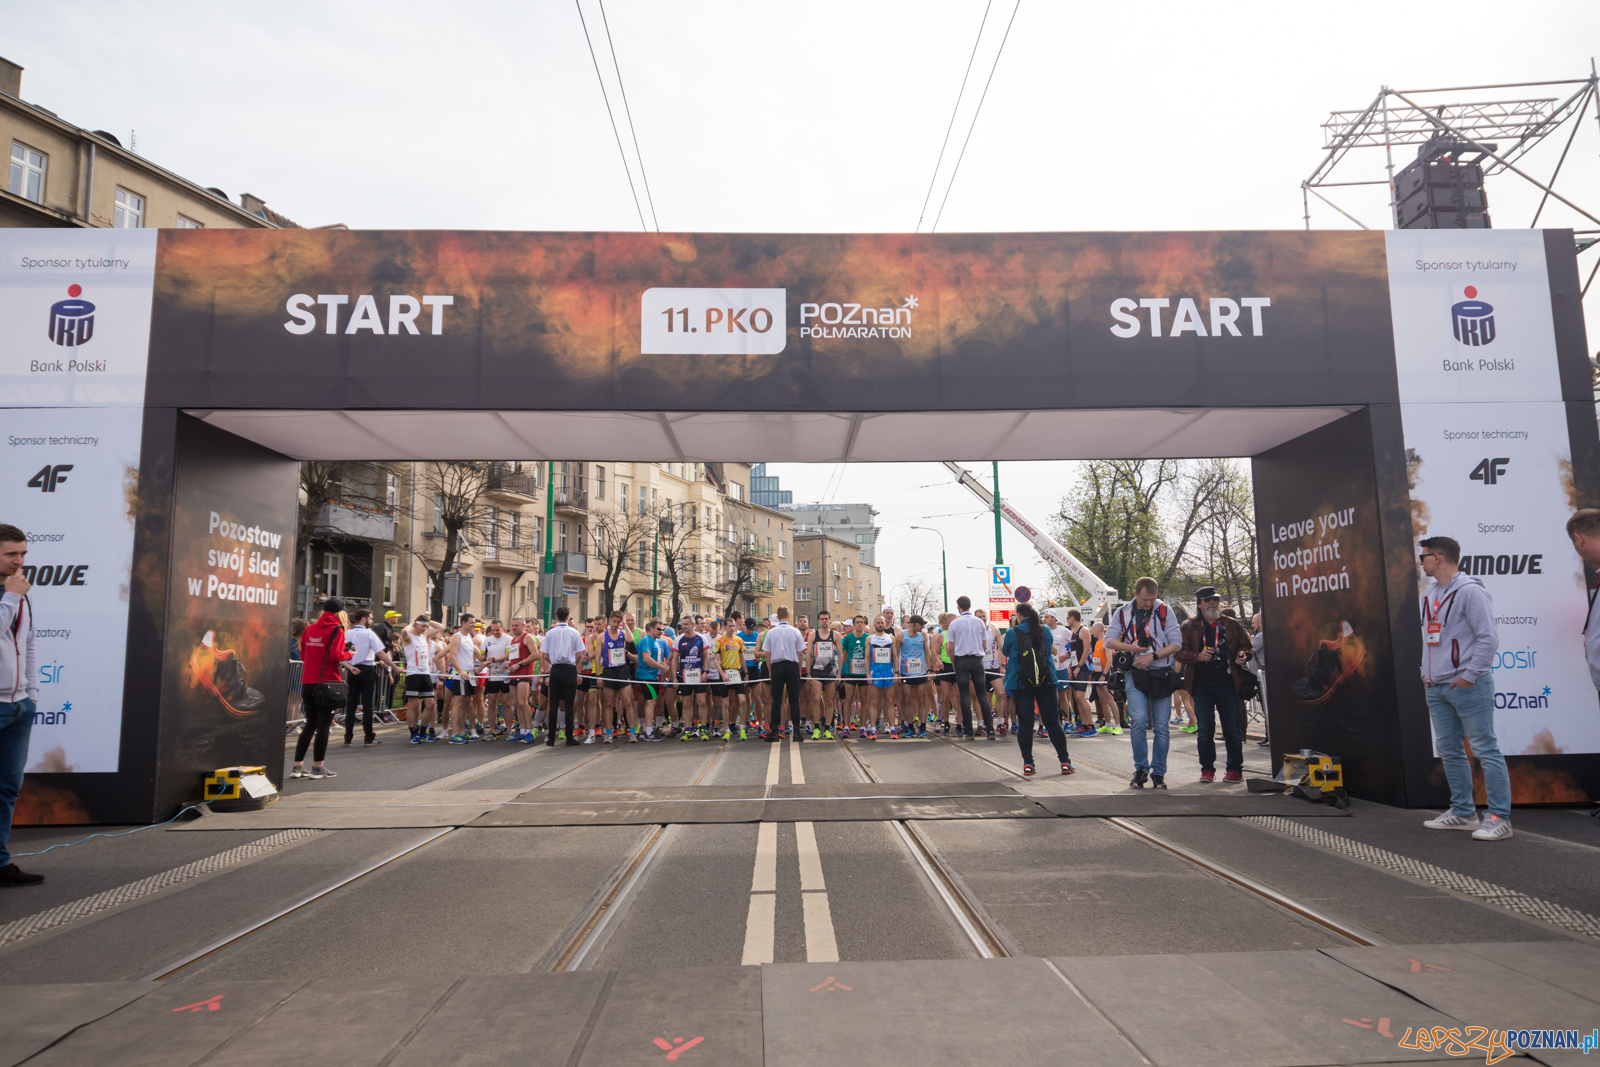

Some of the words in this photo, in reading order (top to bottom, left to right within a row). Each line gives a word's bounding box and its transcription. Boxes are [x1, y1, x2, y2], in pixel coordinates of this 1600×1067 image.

[21, 257, 72, 270] Sponsor
[75, 257, 130, 270] tytularny
[1415, 259, 1463, 272] Sponsor
[1466, 259, 1517, 272] tytularny
[283, 293, 454, 335] START
[661, 307, 697, 333] 11.
[705, 307, 773, 334] PKO
[1109, 297, 1271, 338] START
[800, 324, 911, 339] PÓŁMARATON
[30, 359, 63, 372] Bank
[68, 359, 107, 372] Polski
[1443, 359, 1475, 372] Bank
[1479, 358, 1515, 371] Polski
[8, 435, 46, 447] Sponsor
[48, 435, 99, 447] techniczny
[1443, 430, 1479, 441] Sponsor
[1482, 429, 1529, 440] techniczny
[27, 464, 74, 492] 4F
[1469, 457, 1510, 485] 4F
[208, 511, 281, 549] Pozostaw
[1271, 518, 1315, 543] Leave
[1318, 507, 1355, 537] your
[1477, 523, 1514, 534] Sponsor
[25, 532, 64, 543] Sponsor
[208, 546, 244, 576] swój
[248, 549, 279, 577] ślad
[1273, 539, 1340, 570] footprint
[187, 577, 202, 596] w
[207, 574, 278, 605] Poznaniu
[1275, 577, 1288, 598] in
[1292, 566, 1350, 596] Poznań
[1495, 615, 1538, 626] nizatorzy
[35, 628, 71, 640] zatorzy
